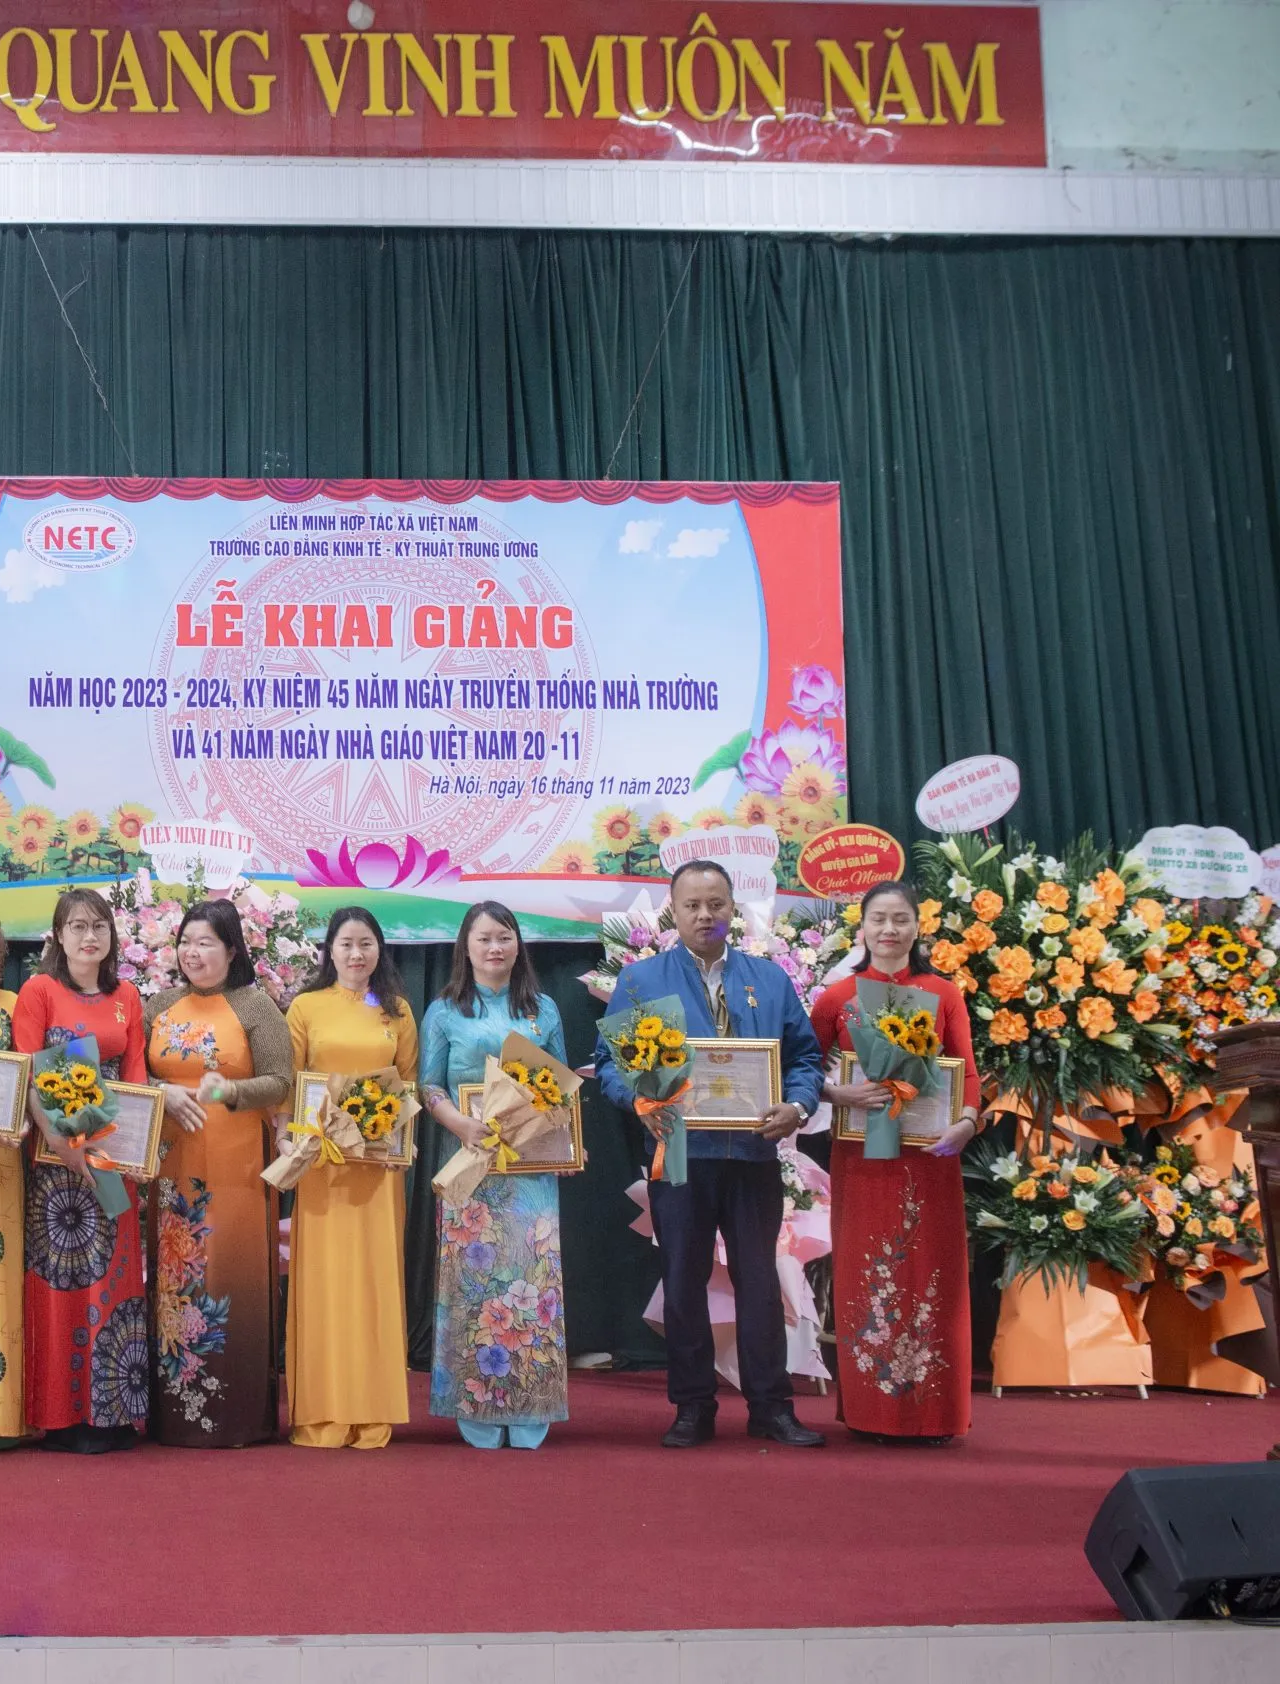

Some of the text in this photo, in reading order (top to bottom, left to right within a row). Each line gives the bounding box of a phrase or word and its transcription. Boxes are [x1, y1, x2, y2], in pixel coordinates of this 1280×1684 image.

[301, 33, 517, 118] VINH
[541, 12, 791, 124] MUÔN
[816, 27, 1005, 126] NĂM
[269, 512, 478, 536] LIÊN MINH HỢP TÁC XÃ VIỆT NAM
[44, 526, 116, 550] NETC
[209, 537, 260, 557] TRƯỜNG
[264, 541, 290, 557] CAO
[293, 534, 329, 557] ĐẲNG
[333, 541, 363, 557] KINH
[367, 535, 382, 557] TẾ
[394, 537, 412, 557] KỸ
[414, 537, 454, 561] THUẬT
[458, 542, 500, 558] TRUNG
[504, 540, 538, 558] ƯƠNG
[176, 579, 573, 649] LỄ KHAI GIẢNG
[29, 671, 72, 708] NĂM
[79, 677, 116, 715] HỌC
[122, 678, 168, 708] 2023
[187, 678, 237, 712] 2024,
[243, 664, 267, 708] KỶ
[273, 672, 320, 715] NIỆM
[327, 679, 349, 709] 45
[356, 672, 399, 709] NĂM
[404, 672, 454, 709] NGÀY
[460, 668, 531, 710] TRUYỀN
[536, 668, 596, 710] THỐNG
[603, 673, 640, 710] NHÀ
[646, 672, 718, 711] TRƯỜNG
[172, 723, 197, 759] VÀ
[202, 729, 222, 759] 41
[230, 723, 273, 759] NĂM
[280, 724, 329, 760] NGÀY
[336, 723, 372, 760] NHÀ
[381, 724, 424, 760] GIÁO
[429, 723, 468, 767] VIỆT
[474, 731, 517, 760] NAM
[523, 731, 545, 761] 20
[429, 775, 691, 799] Hà Nội, ngày 16 tháng 11 năm 2023
[175, 826, 207, 846] MINH
[209, 829, 235, 850] HTX
[816, 875, 849, 891] Chúc
